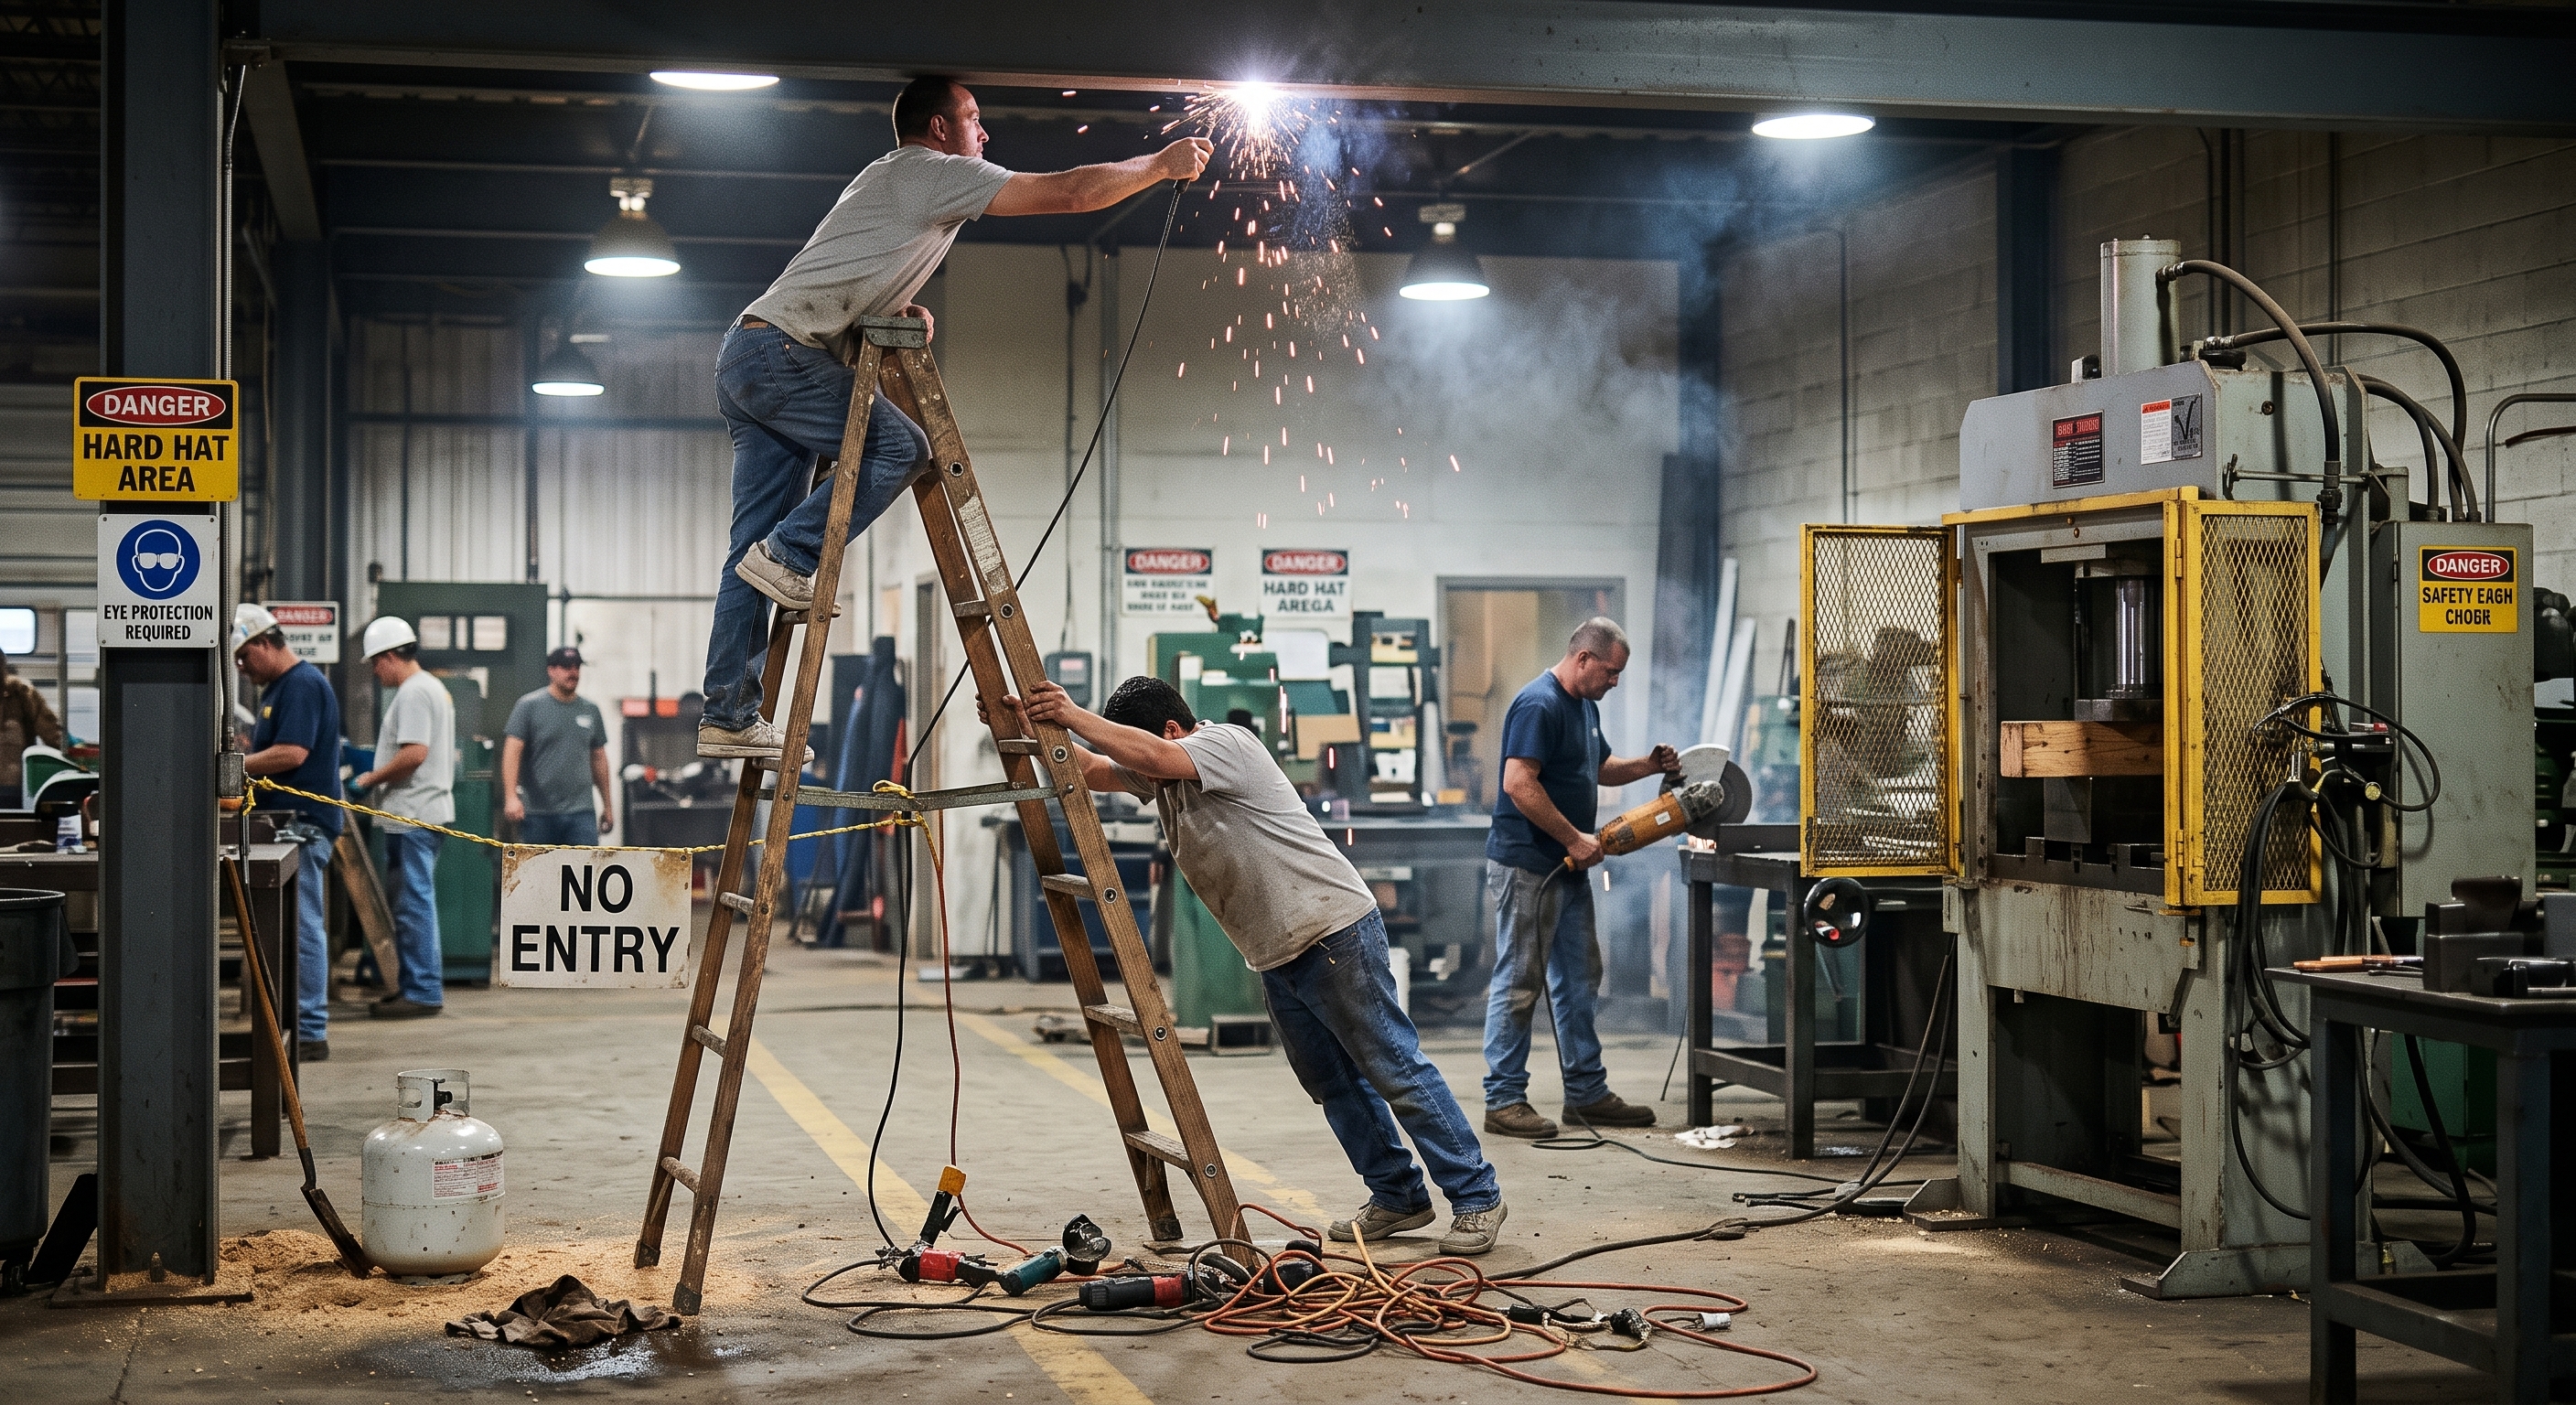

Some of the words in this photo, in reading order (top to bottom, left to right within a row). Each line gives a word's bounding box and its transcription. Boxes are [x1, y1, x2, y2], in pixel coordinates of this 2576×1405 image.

[103, 393, 210, 416] DANGER
[83, 434, 163, 460] HARD
[174, 434, 230, 461] HAT
[117, 466, 196, 492] AREA
[1135, 553, 1202, 569] DANGER
[1272, 554, 1338, 570] DANGER
[2436, 558, 2501, 574] DANGER
[1263, 582, 1308, 595] HARD
[1315, 582, 1346, 595] HAT
[2422, 586, 2474, 604] SAFETY
[103, 605, 127, 620] EYE
[132, 605, 213, 620] PROTECTION
[125, 624, 191, 641] REQUIRED
[560, 863, 634, 914] NO
[511, 924, 681, 973] ENTRY
